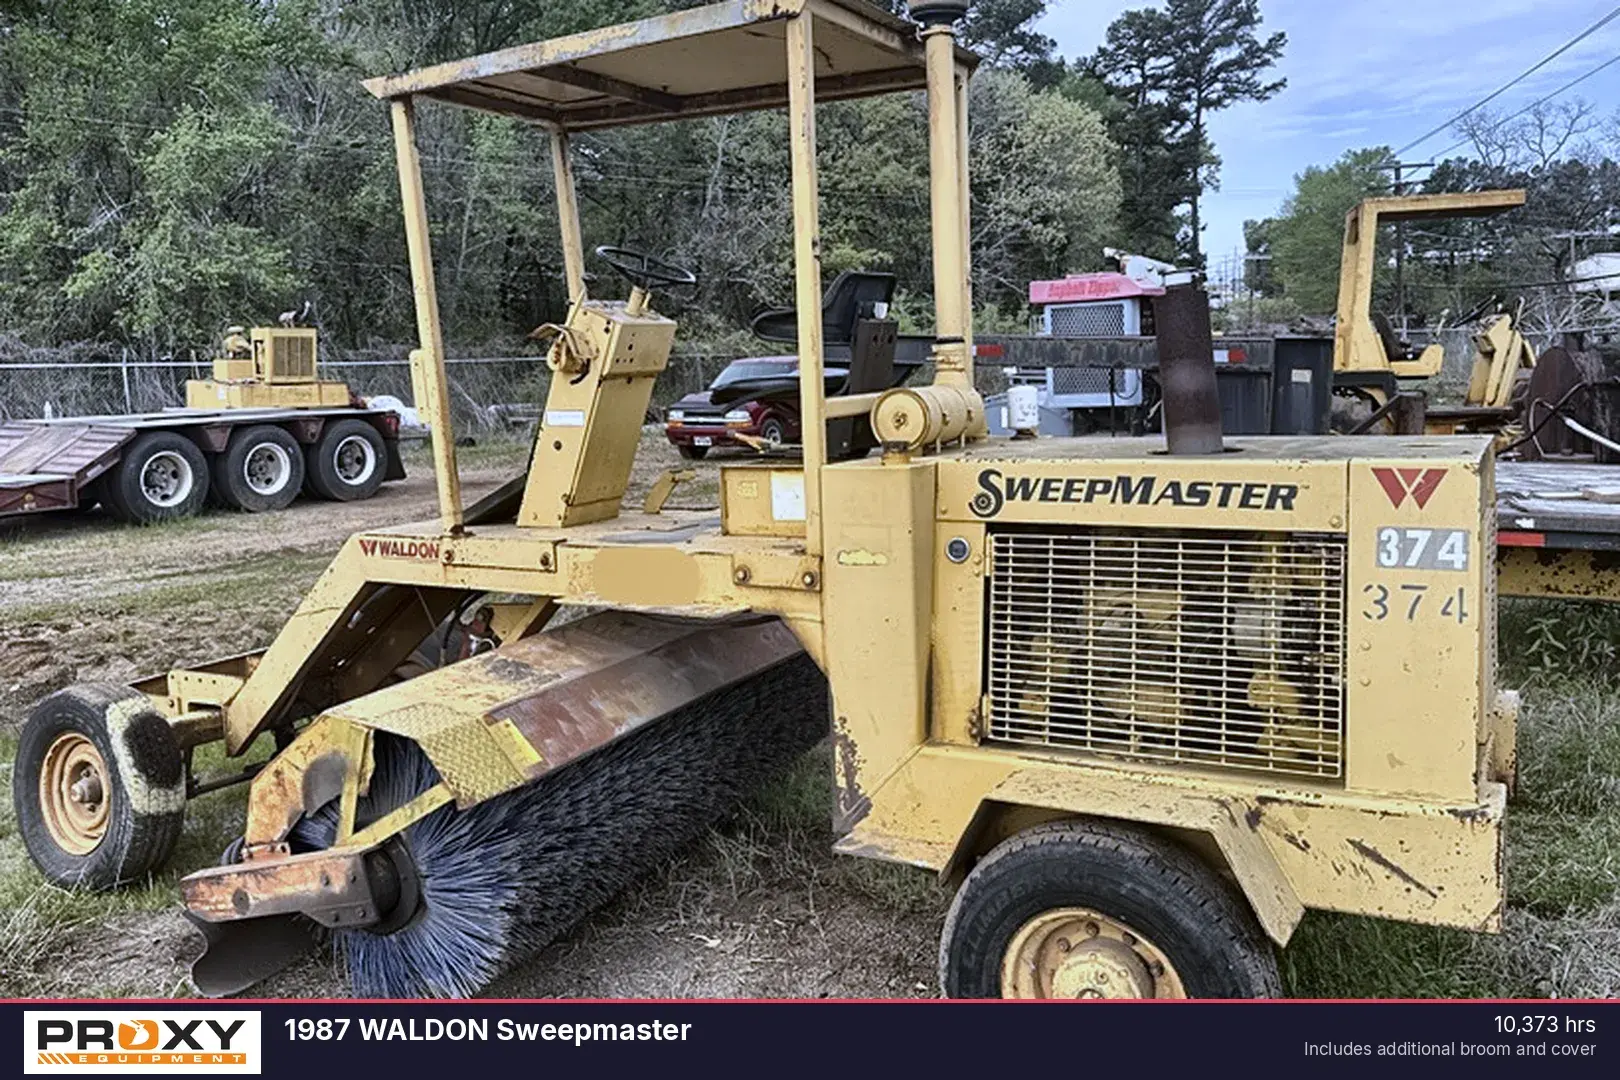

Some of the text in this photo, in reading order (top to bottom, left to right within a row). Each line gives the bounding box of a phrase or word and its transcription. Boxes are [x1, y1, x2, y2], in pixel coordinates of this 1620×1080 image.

[379, 541, 439, 558] WALDON
[1379, 527, 1467, 570] 374
[1362, 584, 1469, 624] 374
